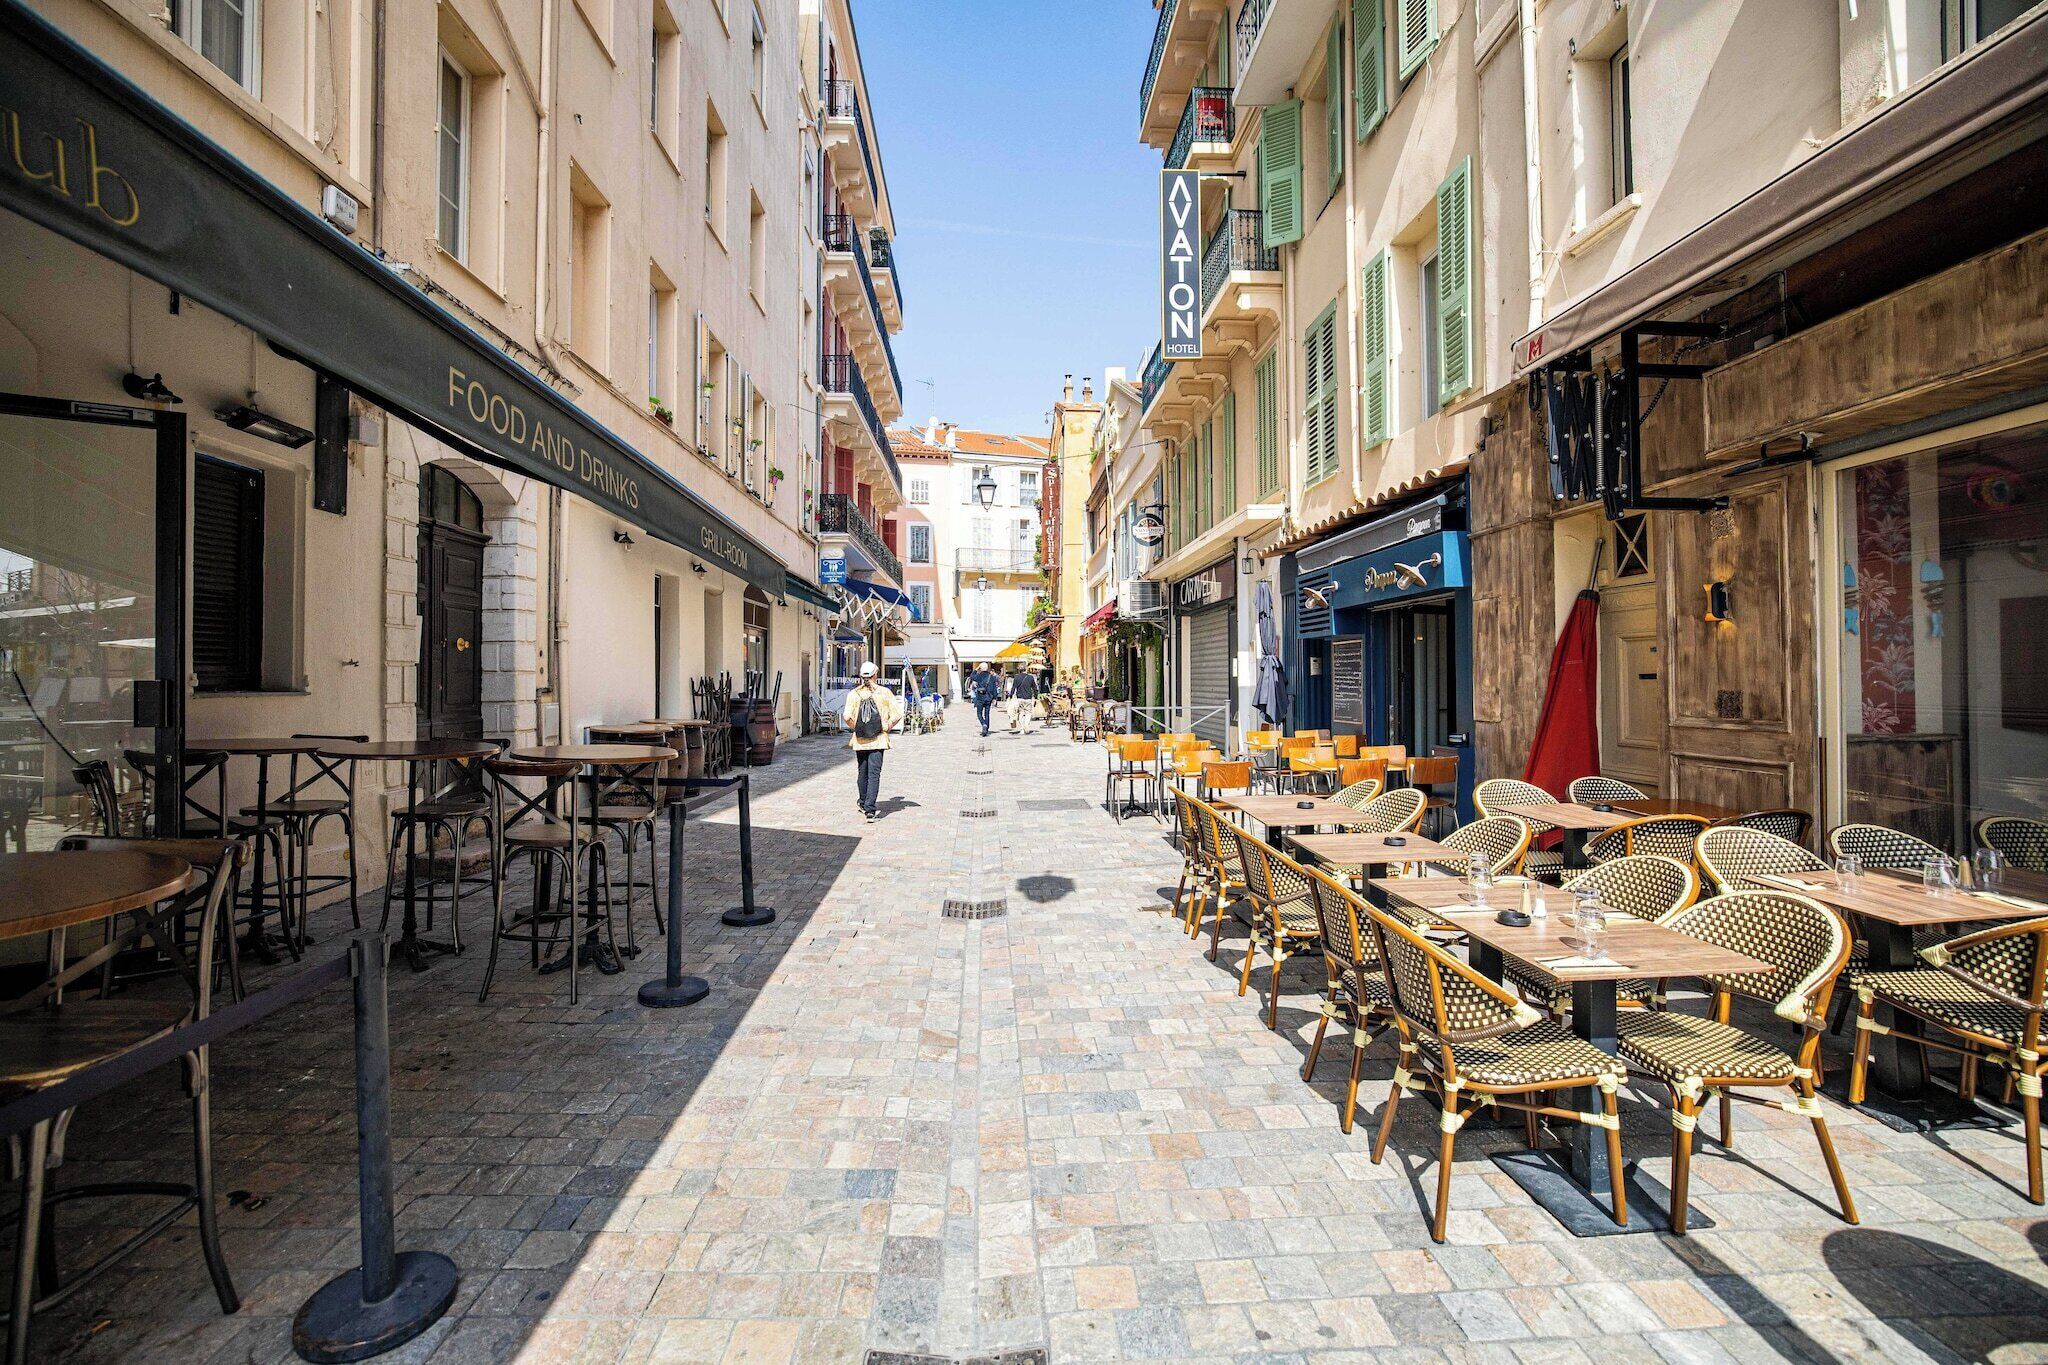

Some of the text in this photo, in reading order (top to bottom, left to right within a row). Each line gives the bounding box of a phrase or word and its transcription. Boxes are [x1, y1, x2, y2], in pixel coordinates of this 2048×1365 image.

[1167, 343, 1200, 354] HOTEL
[449, 365, 639, 509] FOOD AND DRINKS
[1045, 469, 1057, 518] Spirit
[701, 526, 748, 571] GRILL-ROOM
[1180, 567, 1216, 605] CARAVELA
